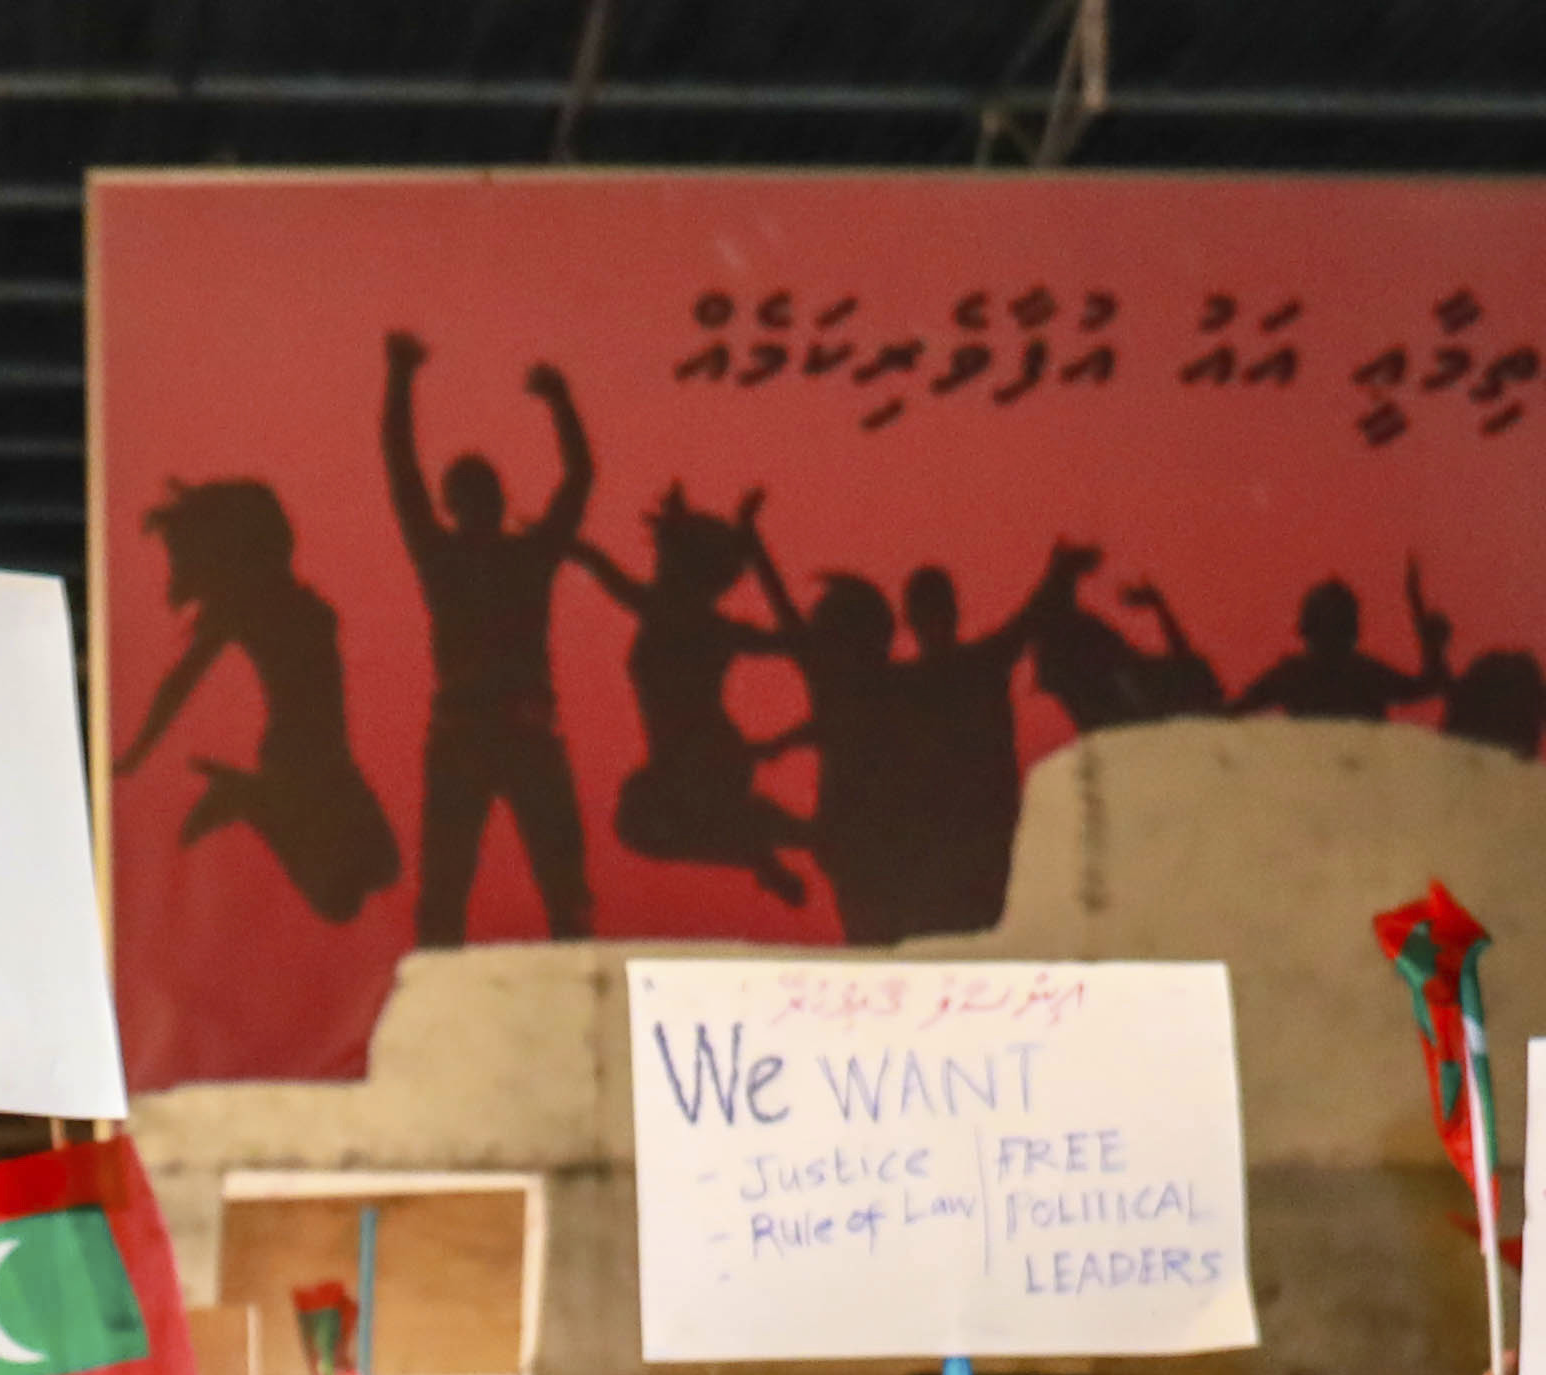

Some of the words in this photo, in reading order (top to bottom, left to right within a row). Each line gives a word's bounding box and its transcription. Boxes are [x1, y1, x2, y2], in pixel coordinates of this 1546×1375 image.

[653, 1020, 790, 1126] We
[818, 1042, 1047, 1122] WANT
[738, 1144, 931, 1201] Justice
[996, 1128, 1128, 1180] FREE
[751, 1211, 834, 1258] Rule
[846, 1197, 887, 1254] of
[903, 1190, 976, 1226] Law
[1005, 1179, 1212, 1240] POLITICAL
[1024, 1247, 1224, 1297] LEADERS
